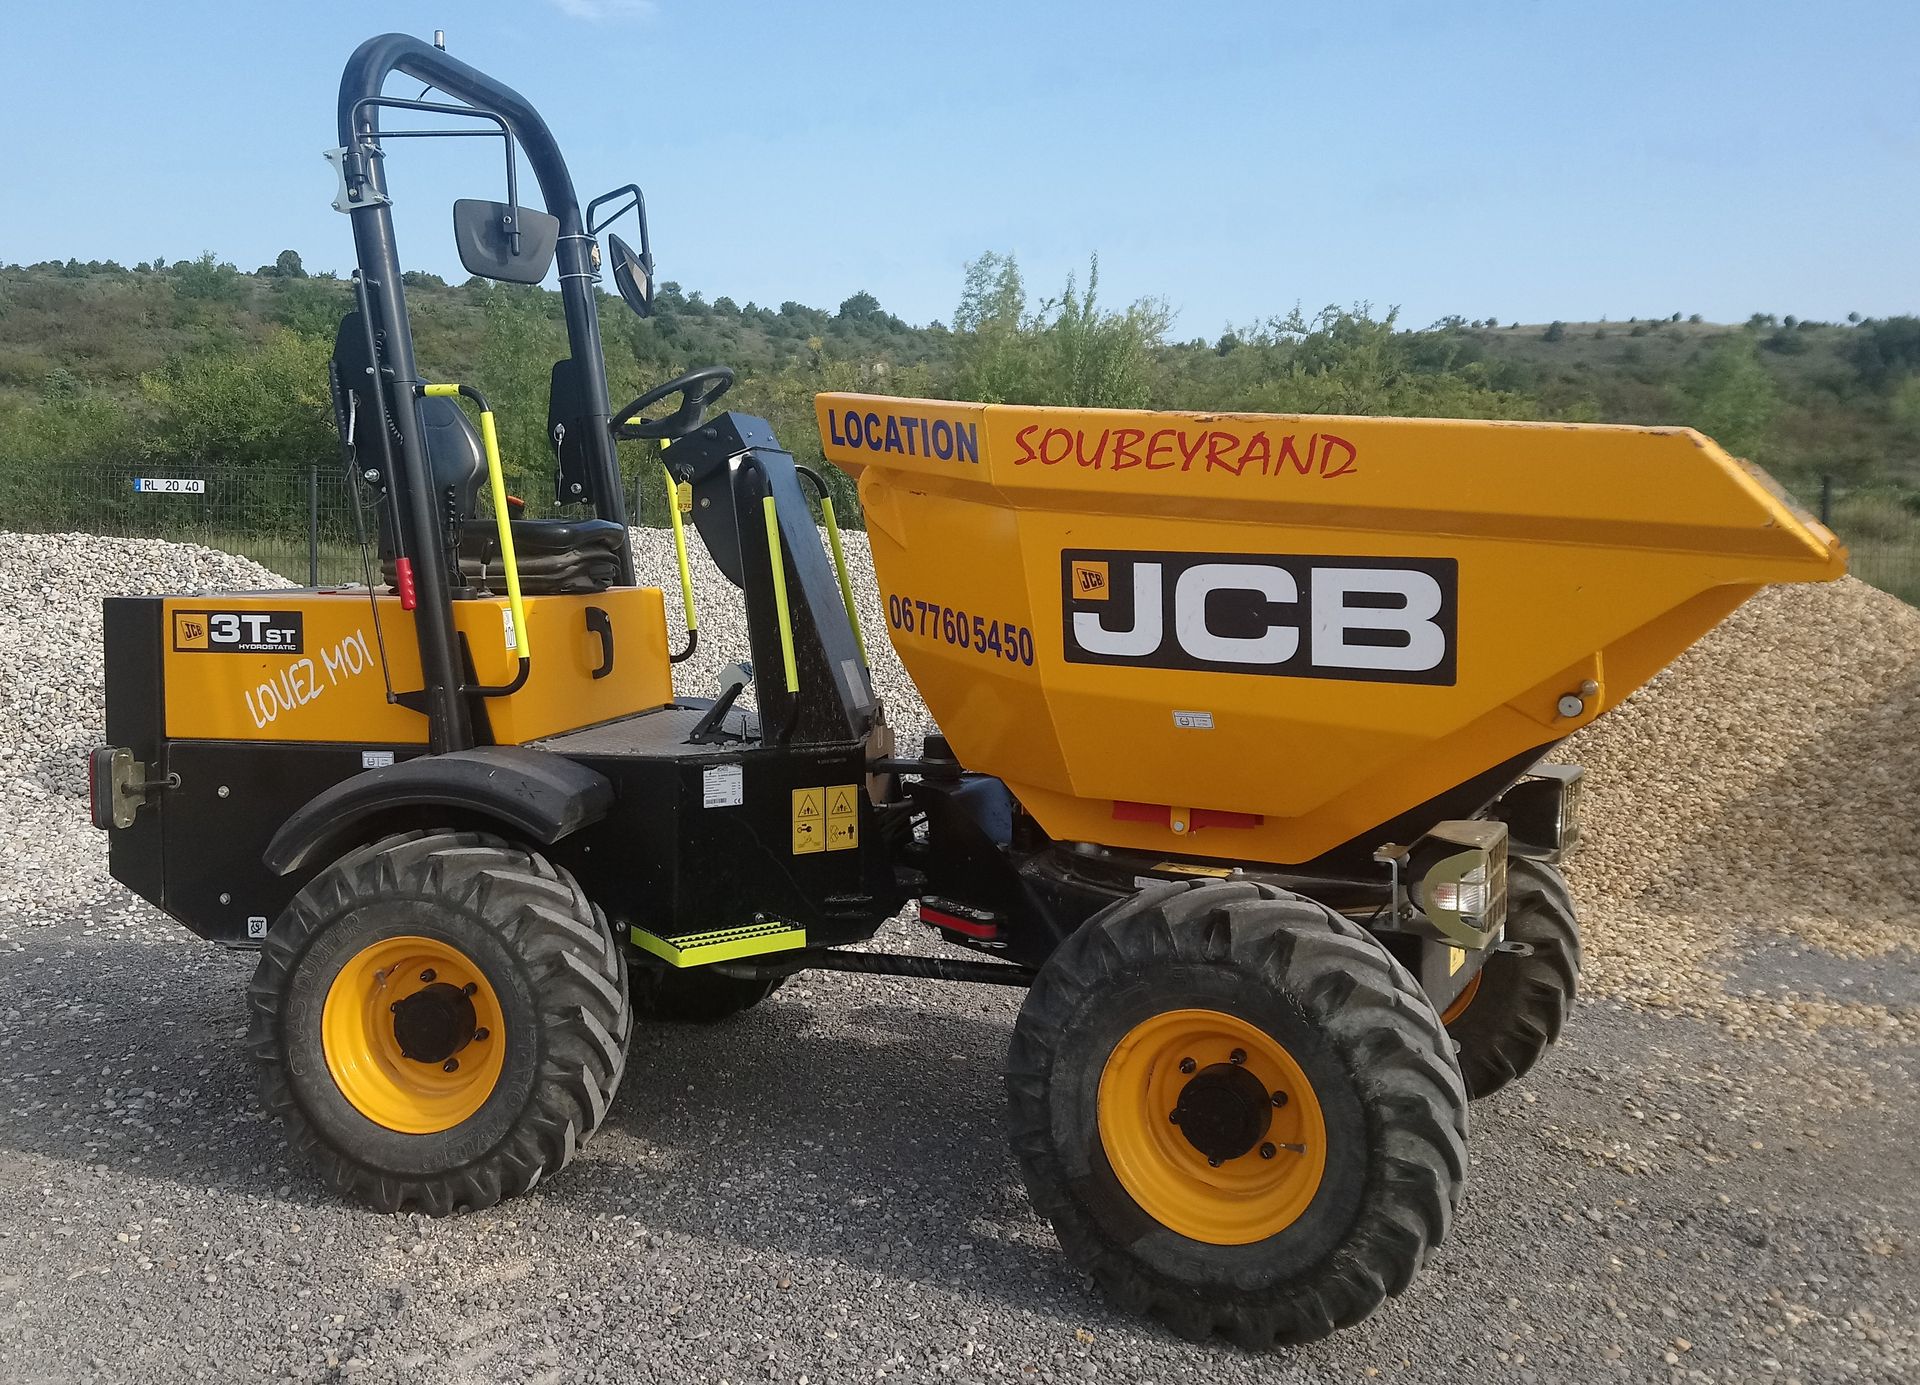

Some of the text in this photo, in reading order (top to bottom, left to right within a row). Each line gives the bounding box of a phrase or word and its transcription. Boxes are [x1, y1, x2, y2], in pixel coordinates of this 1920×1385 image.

[828, 408, 1359, 480] LOCATION SOUBEYRAND
[144, 479, 199, 492] RL 20 40
[1081, 570, 1103, 589] JCB
[1073, 562, 1446, 672] JCB
[184, 622, 203, 640] JCB
[238, 643, 296, 651] HYDROSTATIC
[244, 628, 374, 729] LOUEZ MOI
